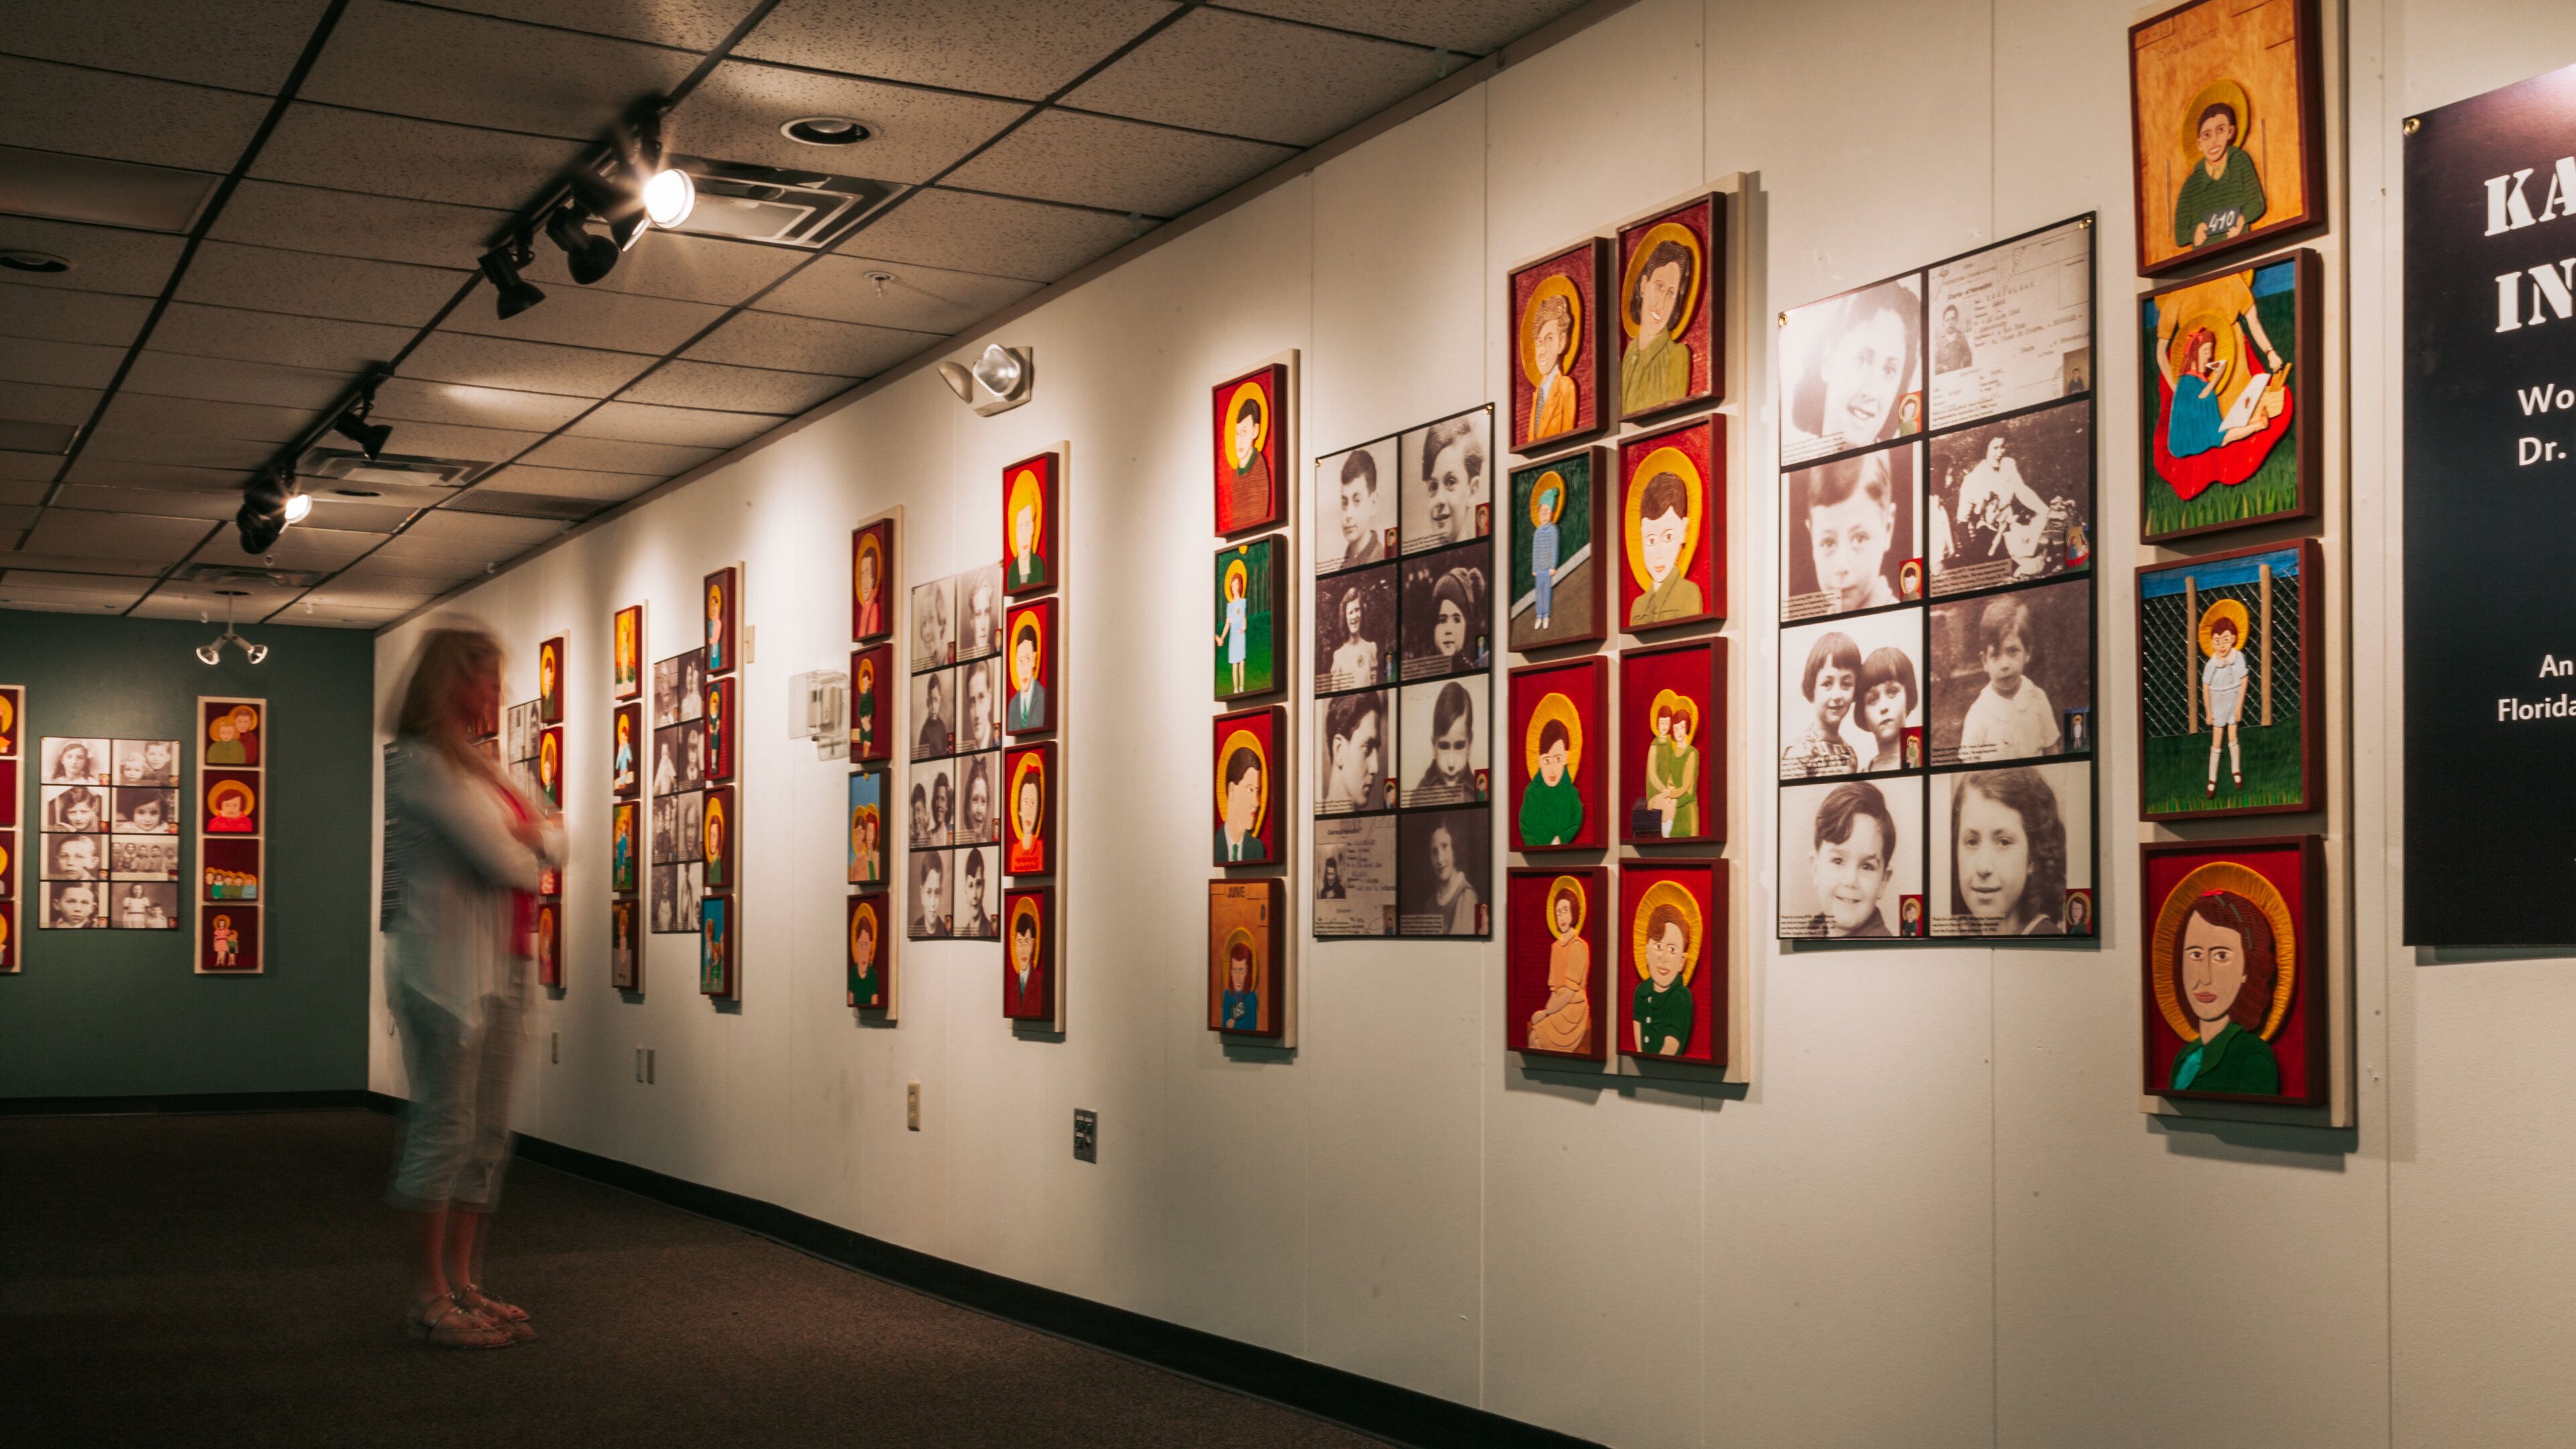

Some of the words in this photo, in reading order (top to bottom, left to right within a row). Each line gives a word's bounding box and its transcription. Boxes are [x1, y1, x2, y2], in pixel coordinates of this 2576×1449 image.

[2483, 156, 2576, 237] KA
[2208, 210, 2236, 231] 410
[2495, 257, 2576, 333] IN
[2517, 383, 2575, 416] Wo
[2518, 437, 2567, 466] Dr.
[2539, 654, 2574, 678] An
[1227, 886, 1246, 898] JUNE
